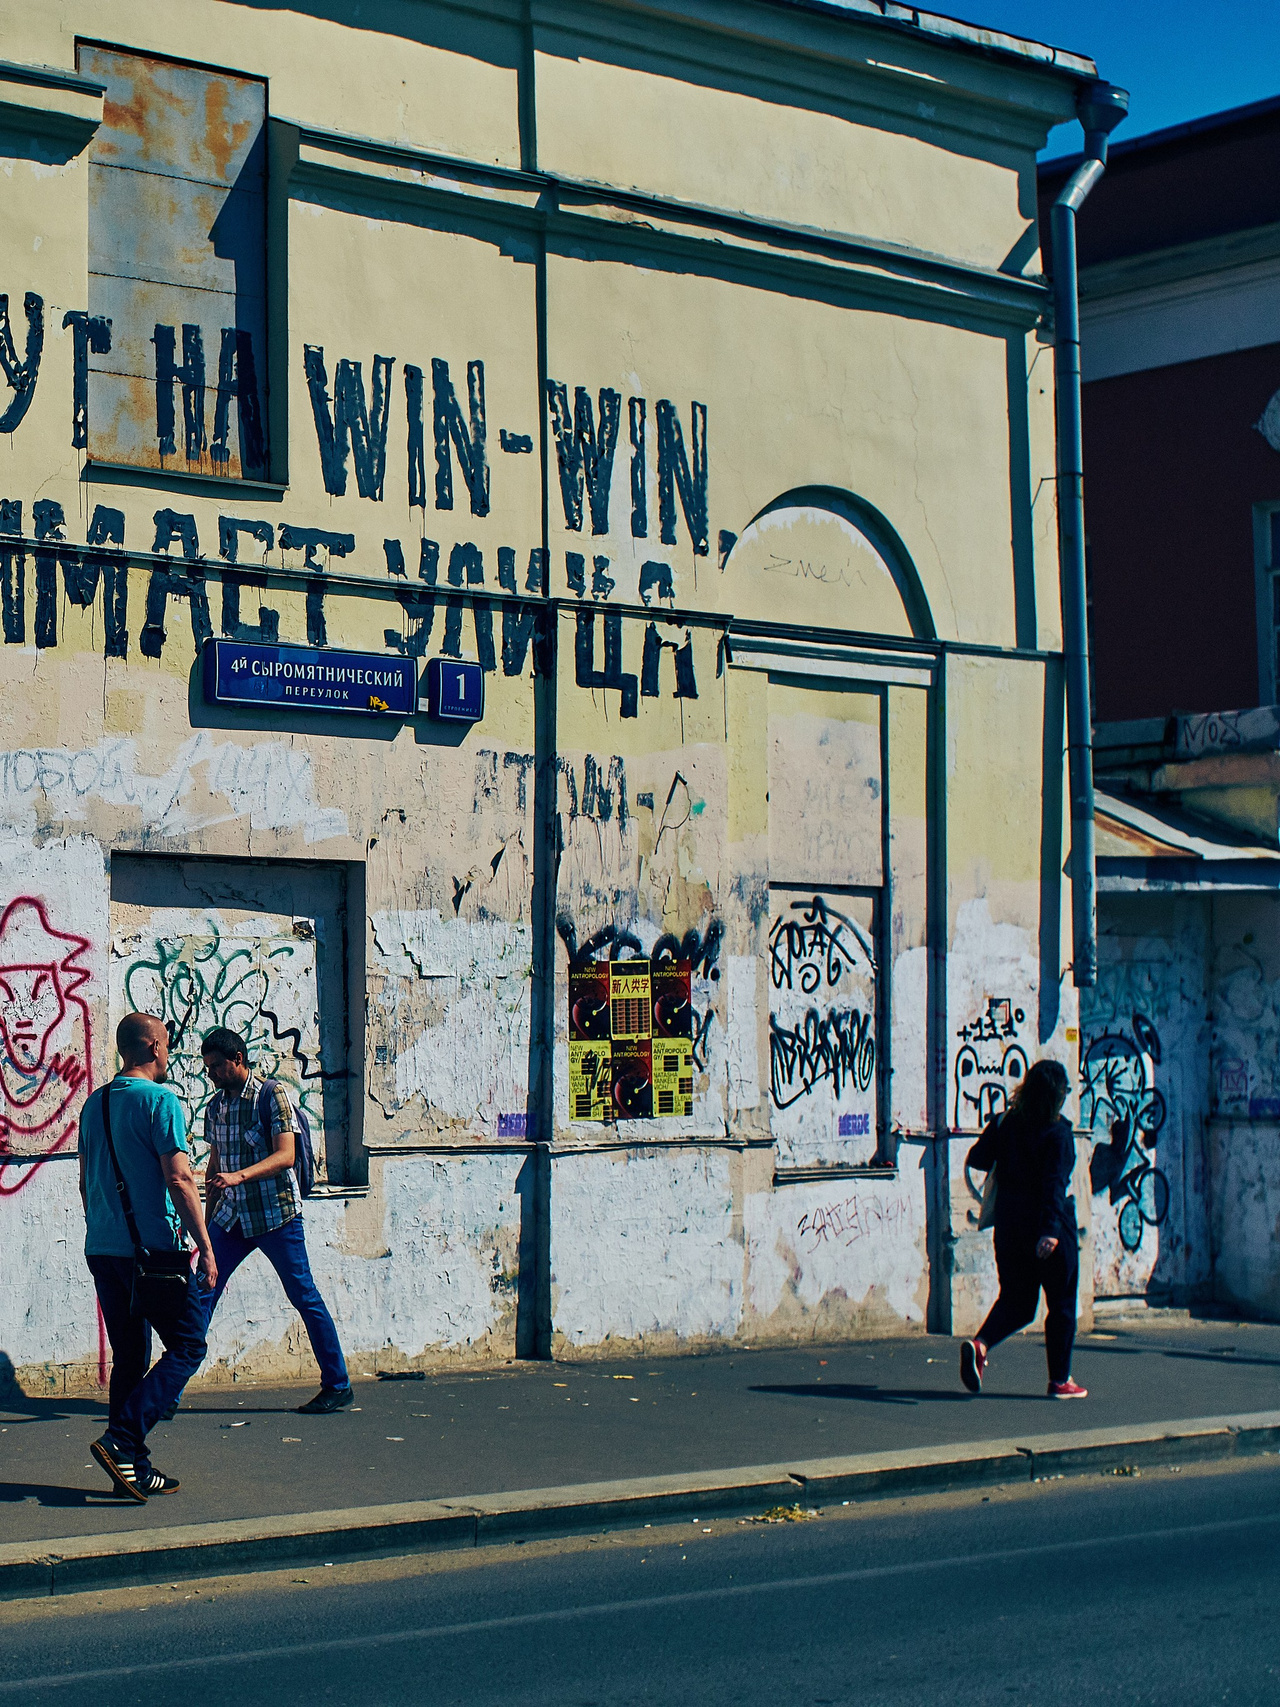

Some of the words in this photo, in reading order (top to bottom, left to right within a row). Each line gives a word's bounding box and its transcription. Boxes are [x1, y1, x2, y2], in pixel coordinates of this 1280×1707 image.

[150, 322, 271, 470] НА
[383, 536, 699, 719] УЛИЦА
[251, 659, 403, 688] СЫРОМЯТНИЧЕСКИЙ
[456, 673, 465, 700] 1
[285, 685, 350, 699] ПЕРЕУЛОК
[611, 978, 650, 994] 新人类学
